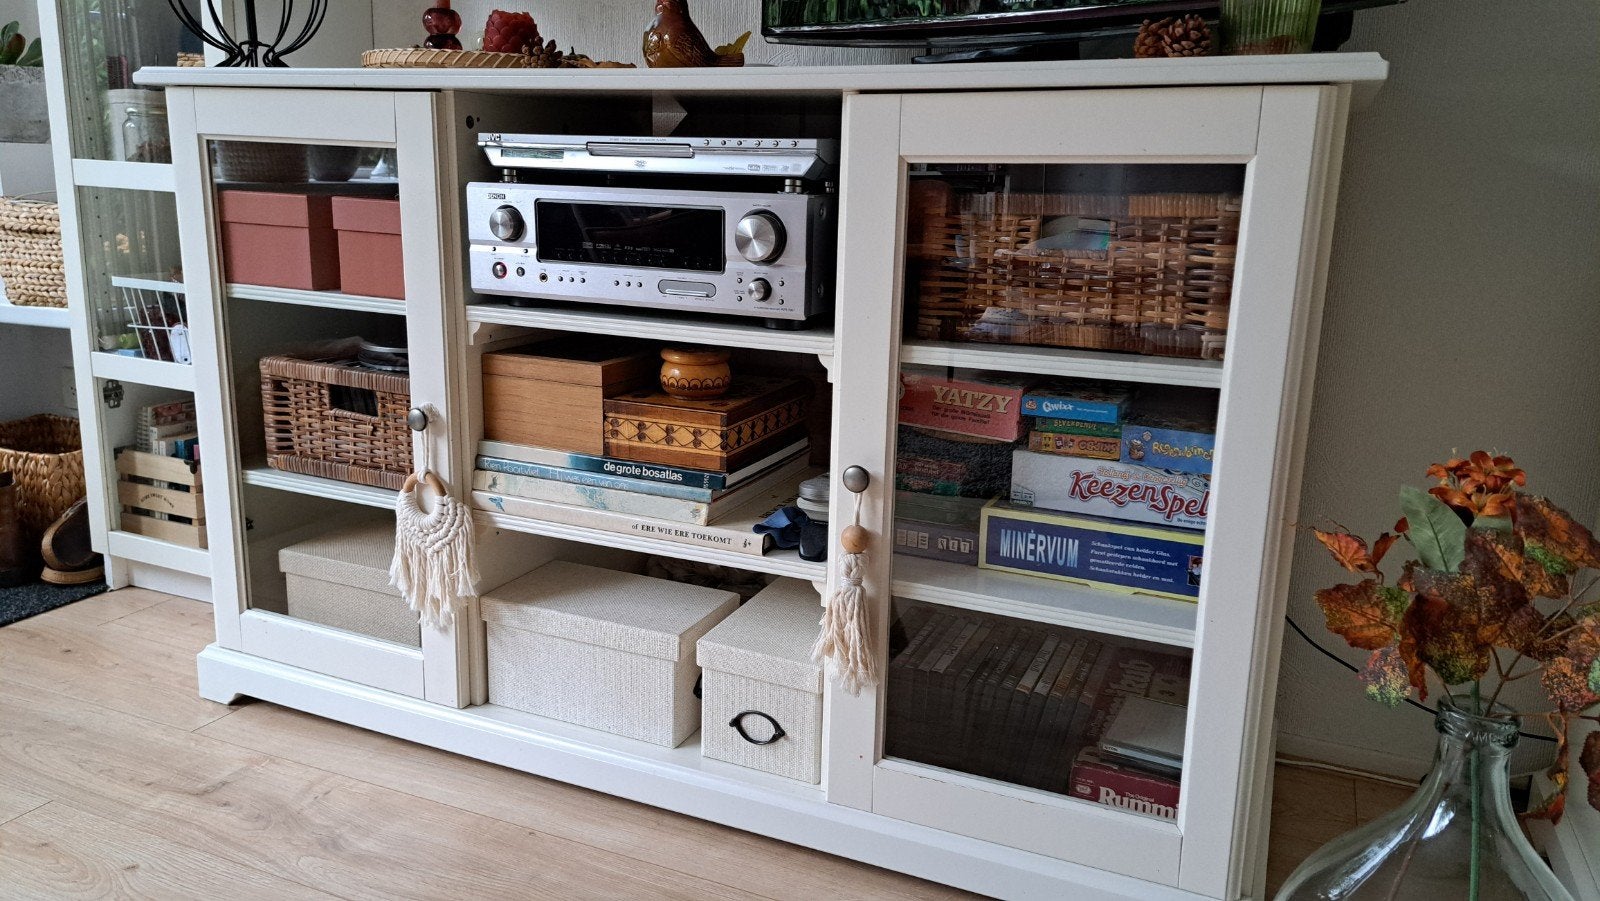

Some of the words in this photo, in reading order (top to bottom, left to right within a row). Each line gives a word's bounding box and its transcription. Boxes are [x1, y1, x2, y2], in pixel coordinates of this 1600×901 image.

[487, 133, 501, 141] JVC
[487, 192, 506, 200] DENON
[932, 385, 1013, 414] YATZY
[1042, 400, 1075, 413] Qwixx
[603, 461, 616, 471] de
[616, 465, 641, 476] grote
[642, 467, 683, 481] bosatlas
[1069, 469, 1210, 521] KeezenSpel
[641, 524, 656, 533] ERE
[657, 527, 673, 536] WIE
[674, 529, 690, 539] ERE
[691, 533, 733, 545] TOEKOMT
